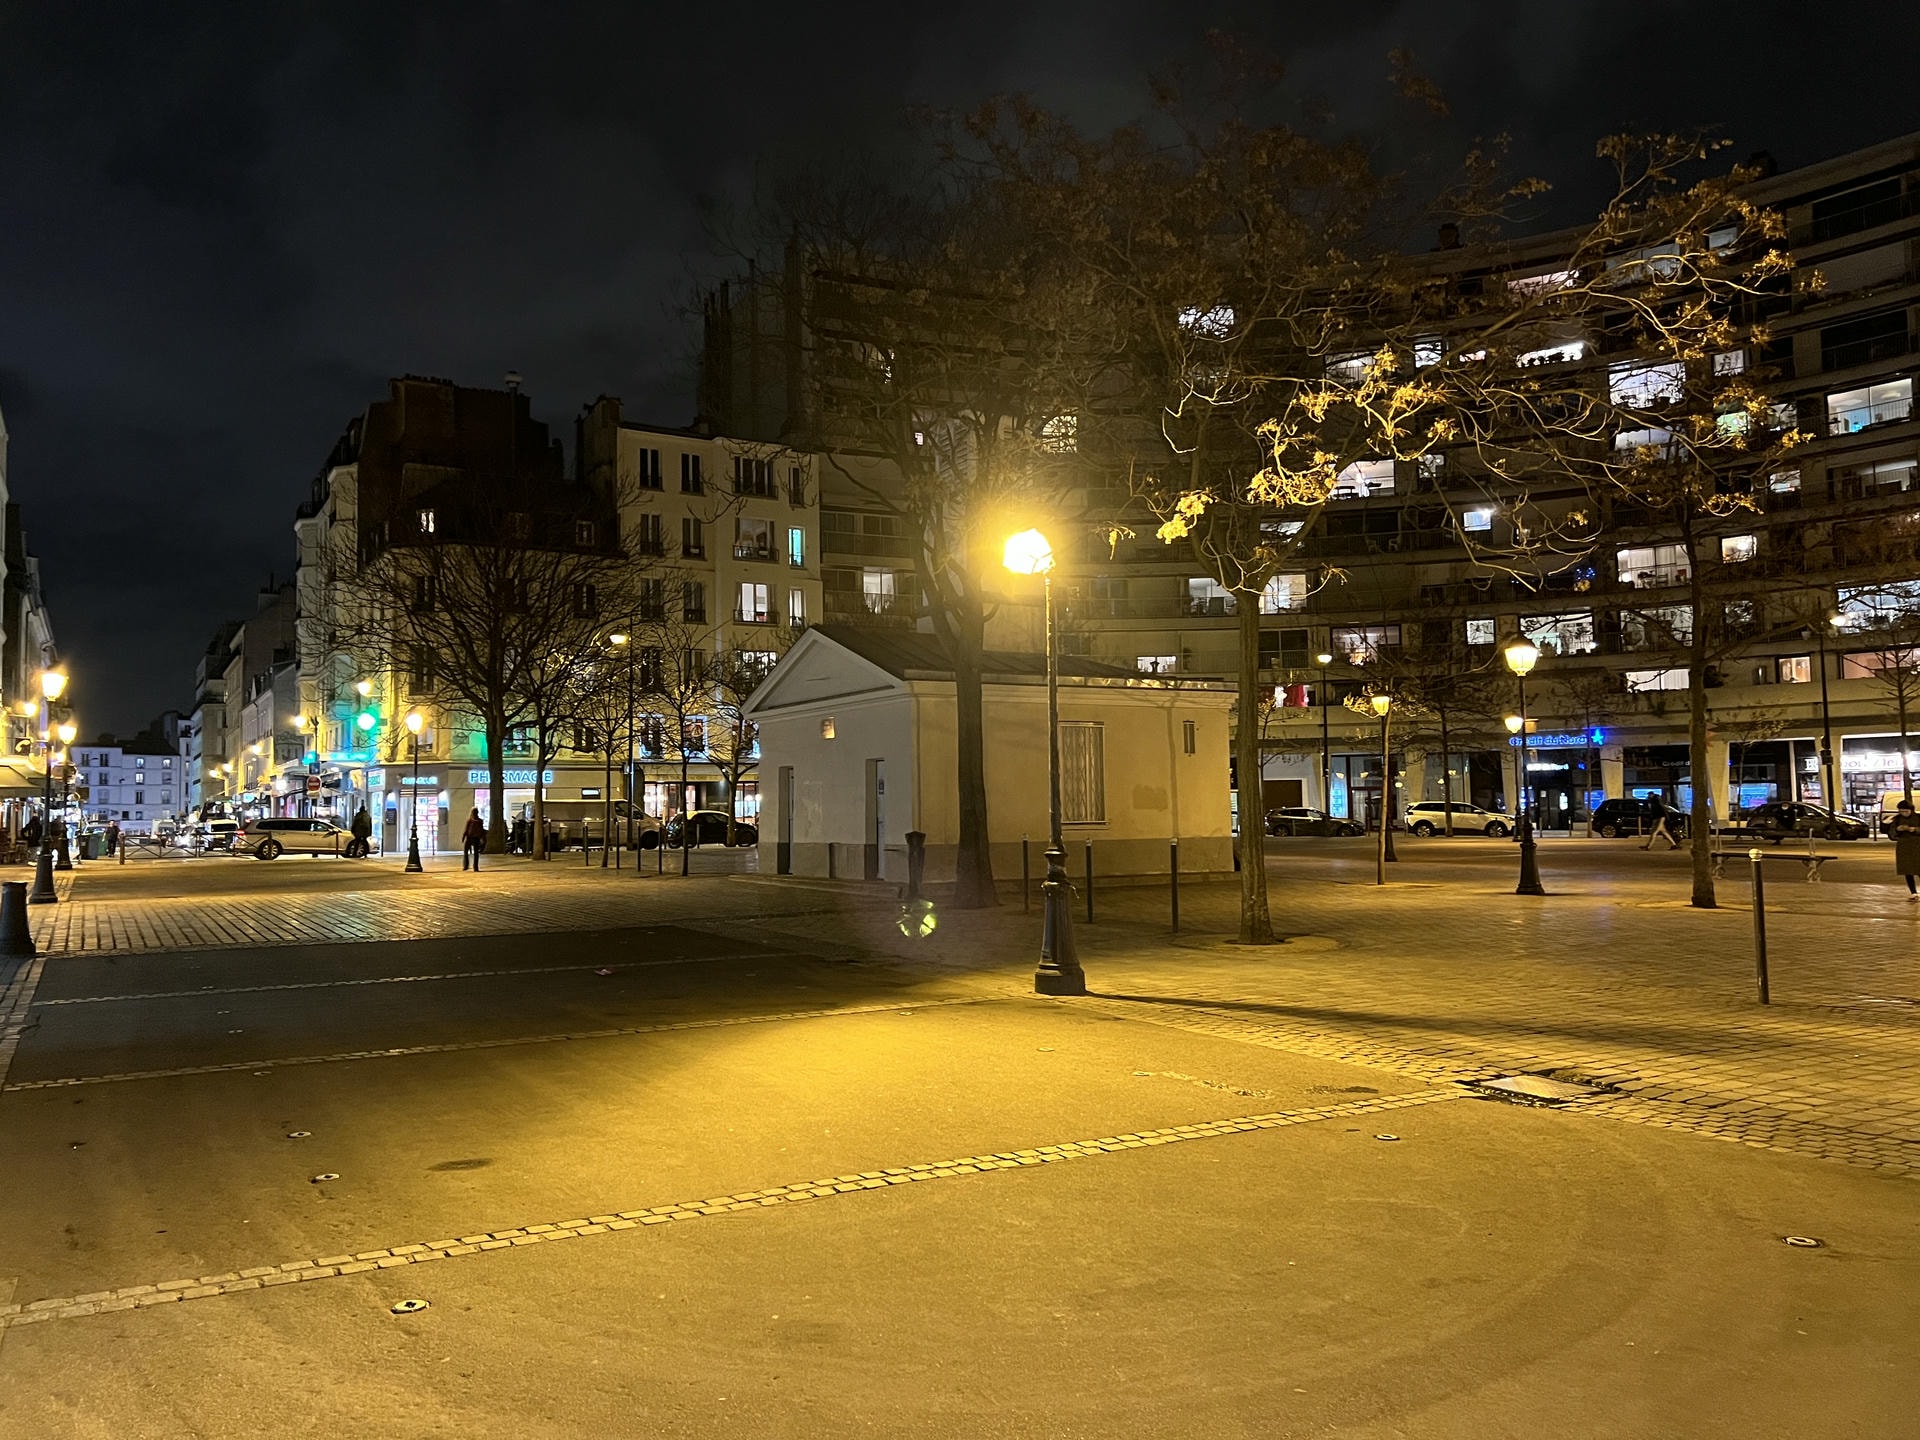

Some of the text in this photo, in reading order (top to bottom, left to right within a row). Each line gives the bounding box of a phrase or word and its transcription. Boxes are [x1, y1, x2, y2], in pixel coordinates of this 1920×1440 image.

[1509, 736, 1543, 746] Crdit
[1559, 734, 1588, 745] Nord
[470, 771, 552, 783] PHRMACE
